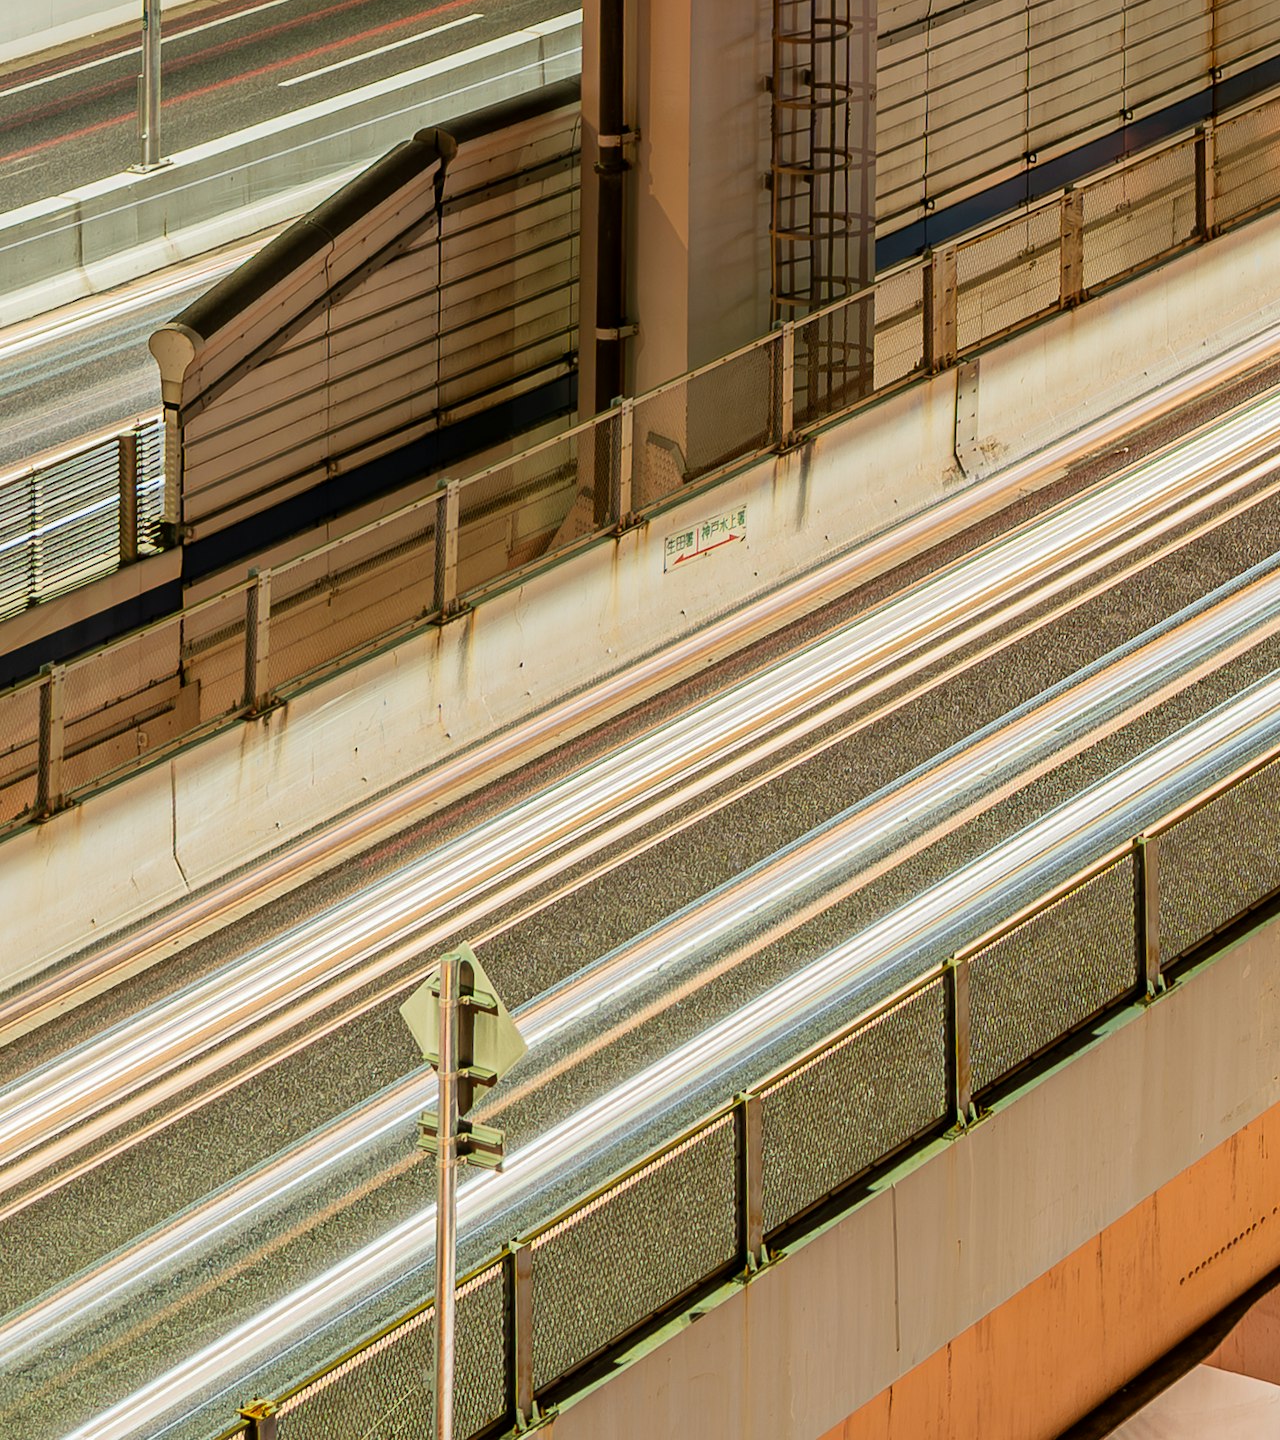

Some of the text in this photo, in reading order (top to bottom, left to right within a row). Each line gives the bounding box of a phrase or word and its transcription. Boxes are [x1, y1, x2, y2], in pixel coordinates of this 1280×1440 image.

[666, 509, 746, 557] 生田署 神戸水上署
